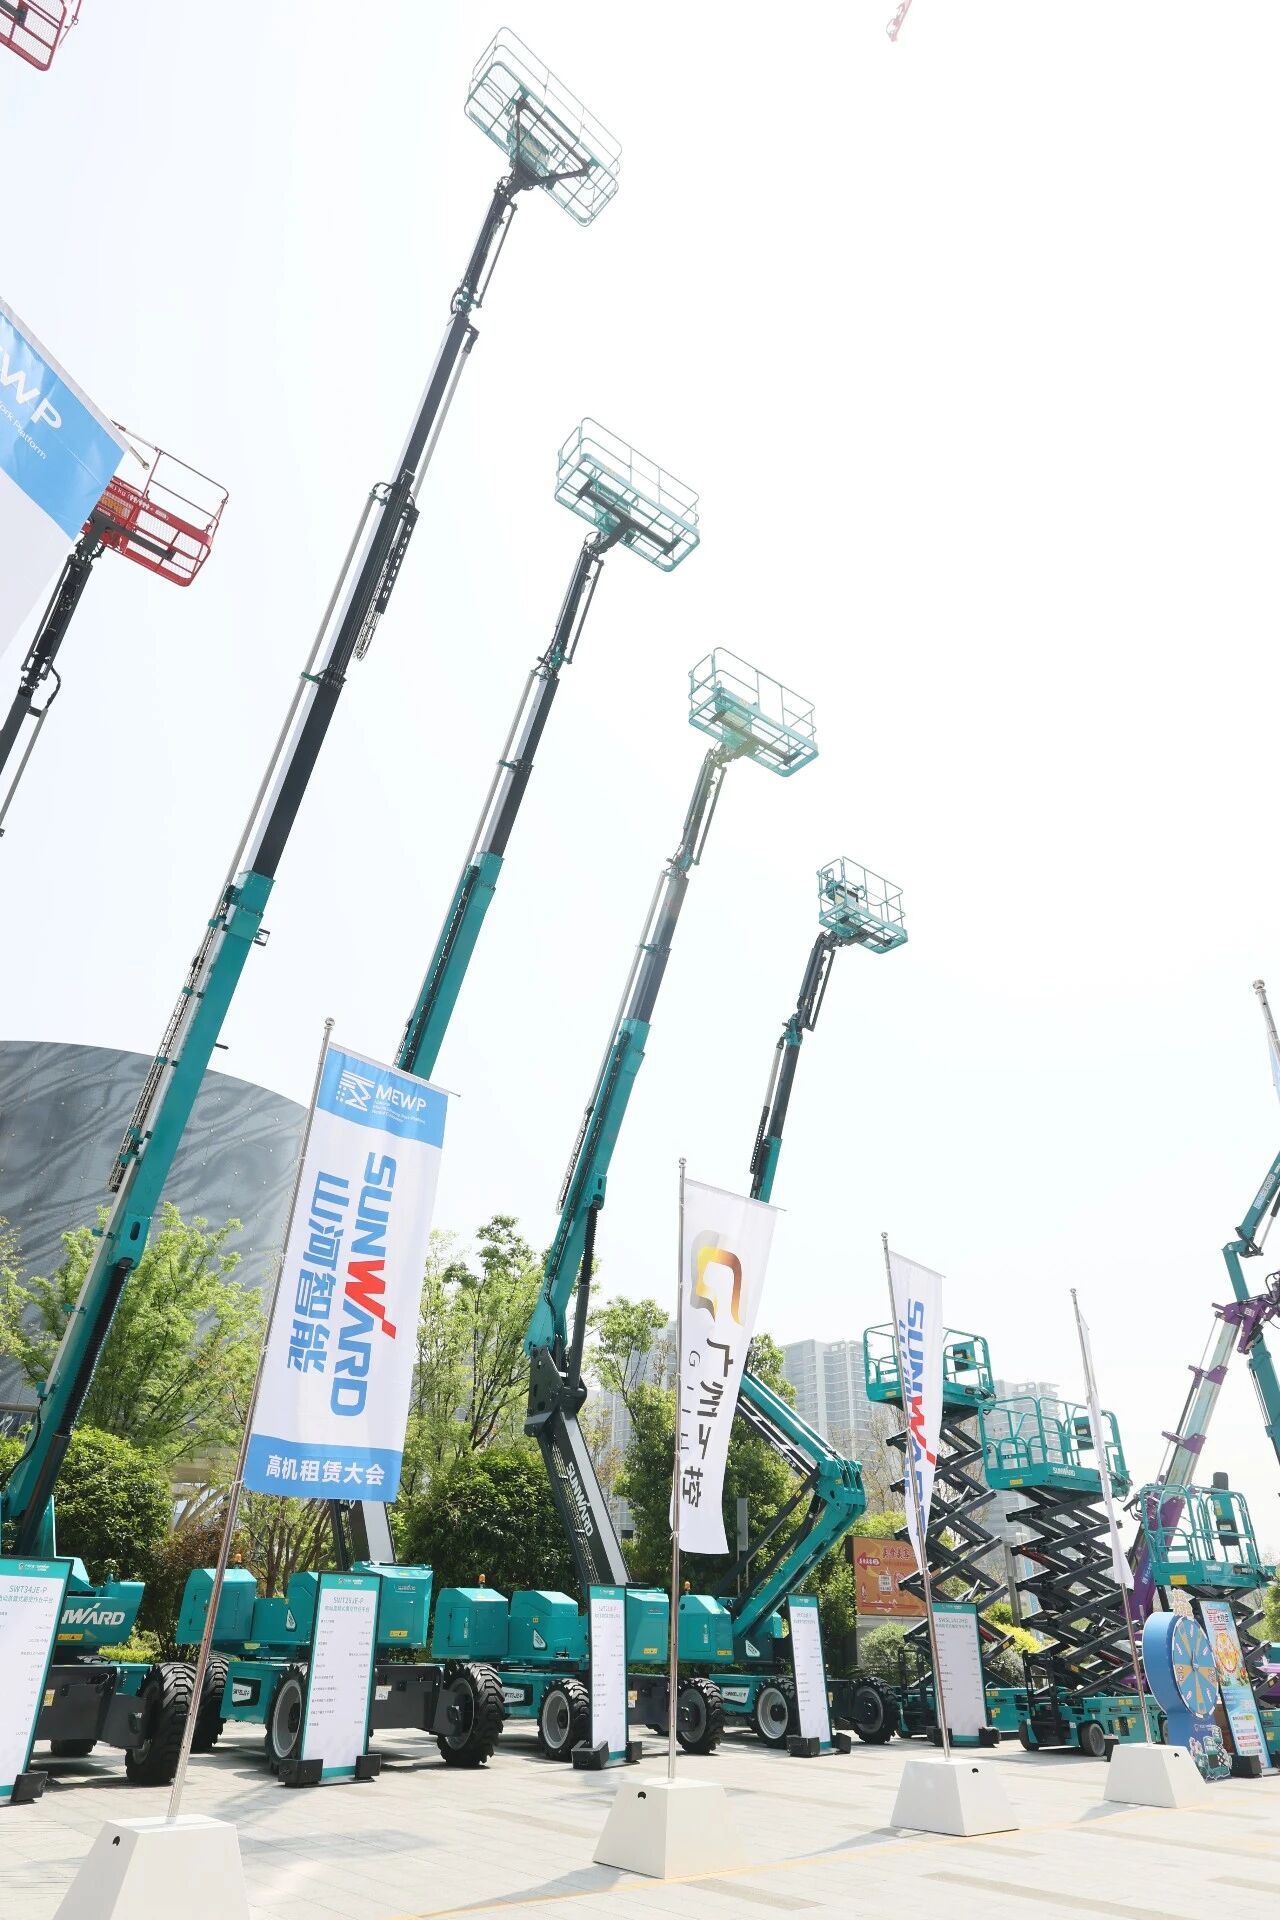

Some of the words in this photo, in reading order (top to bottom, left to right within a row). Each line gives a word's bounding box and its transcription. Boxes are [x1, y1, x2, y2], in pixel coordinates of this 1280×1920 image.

[375, 1084, 427, 1112] MEWP
[288, 1170, 350, 1375] 山河智能
[331, 1152, 398, 1417] SUNWARD
[265, 1453, 386, 1488] 高机租赁大会
[682, 1337, 734, 1508] 广州工控
[565, 1461, 594, 1538] SUNWARD
